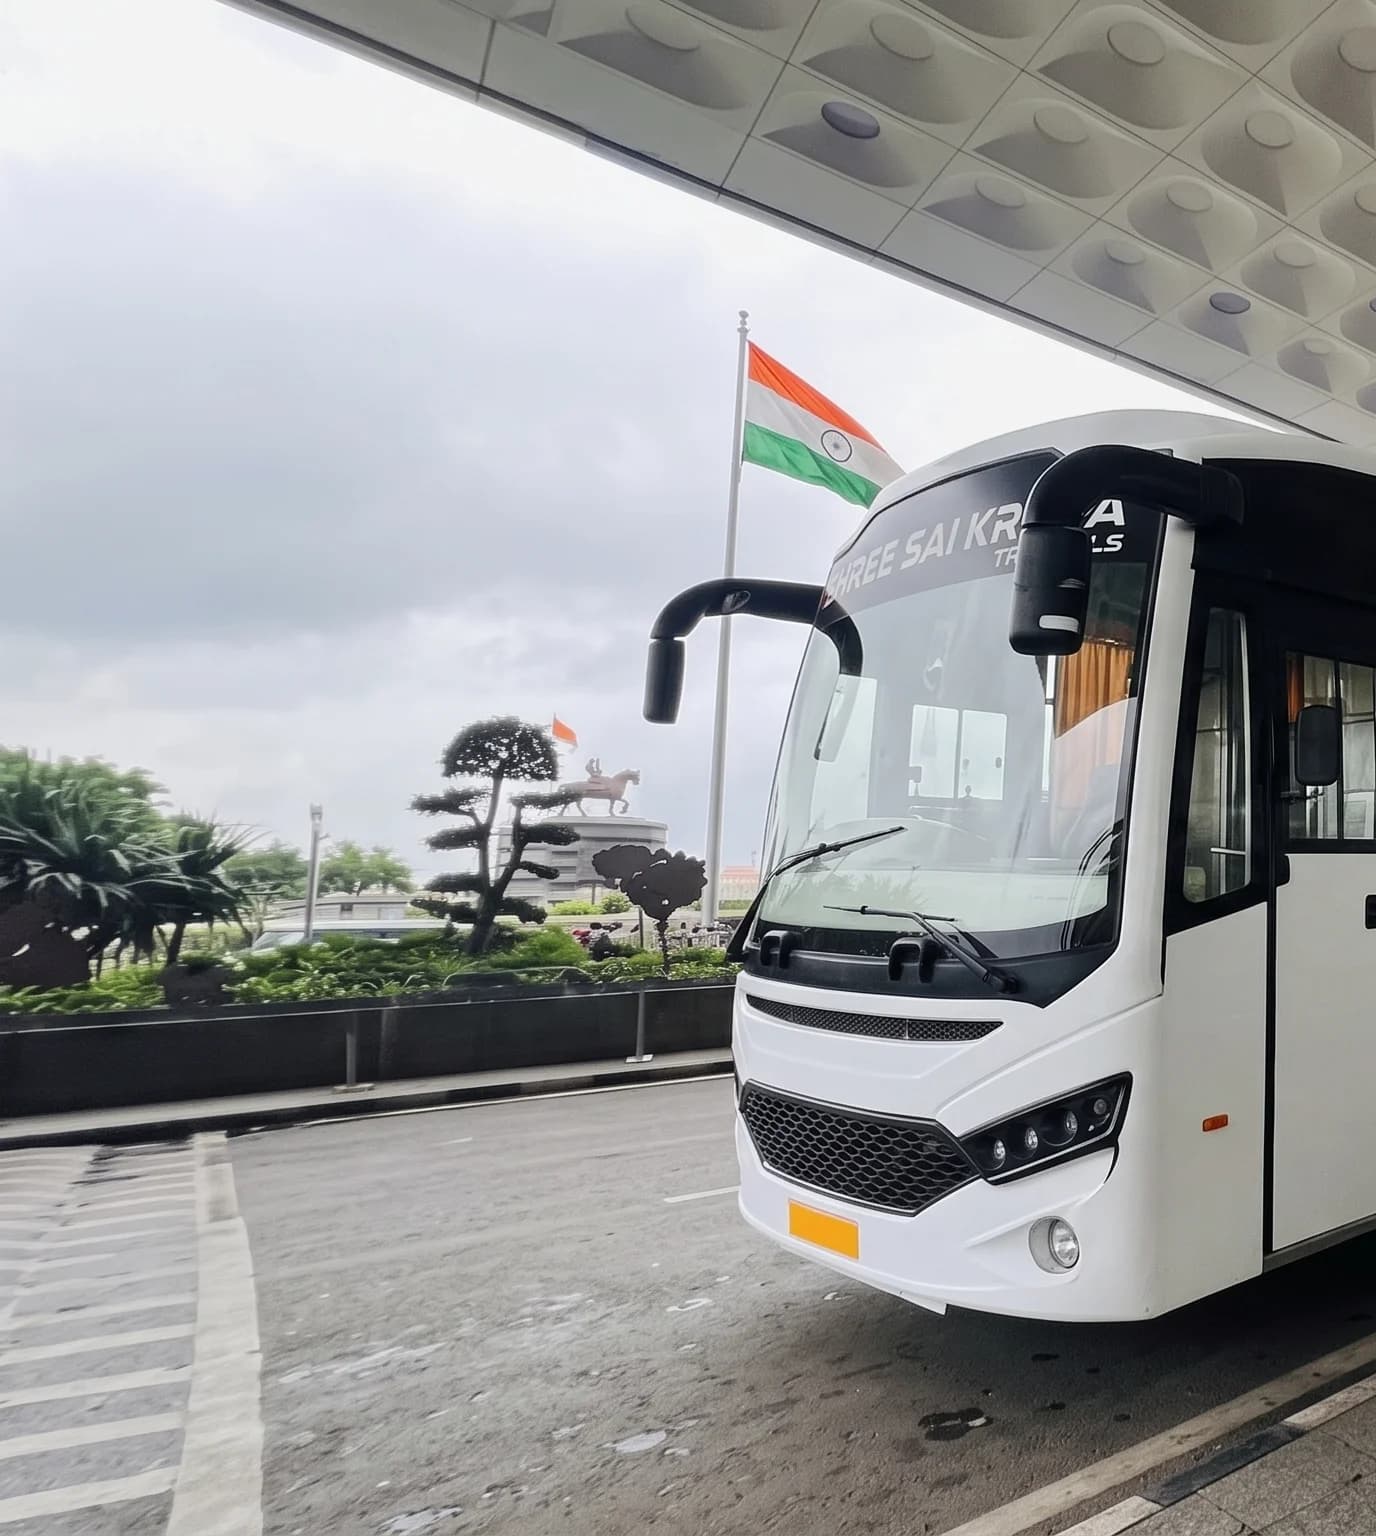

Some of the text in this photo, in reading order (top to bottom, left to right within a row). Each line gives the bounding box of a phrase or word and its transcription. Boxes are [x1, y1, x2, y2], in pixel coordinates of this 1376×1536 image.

[899, 517, 960, 570] SAI
[963, 499, 1125, 550] KRA
[994, 533, 1125, 567] TRLS
